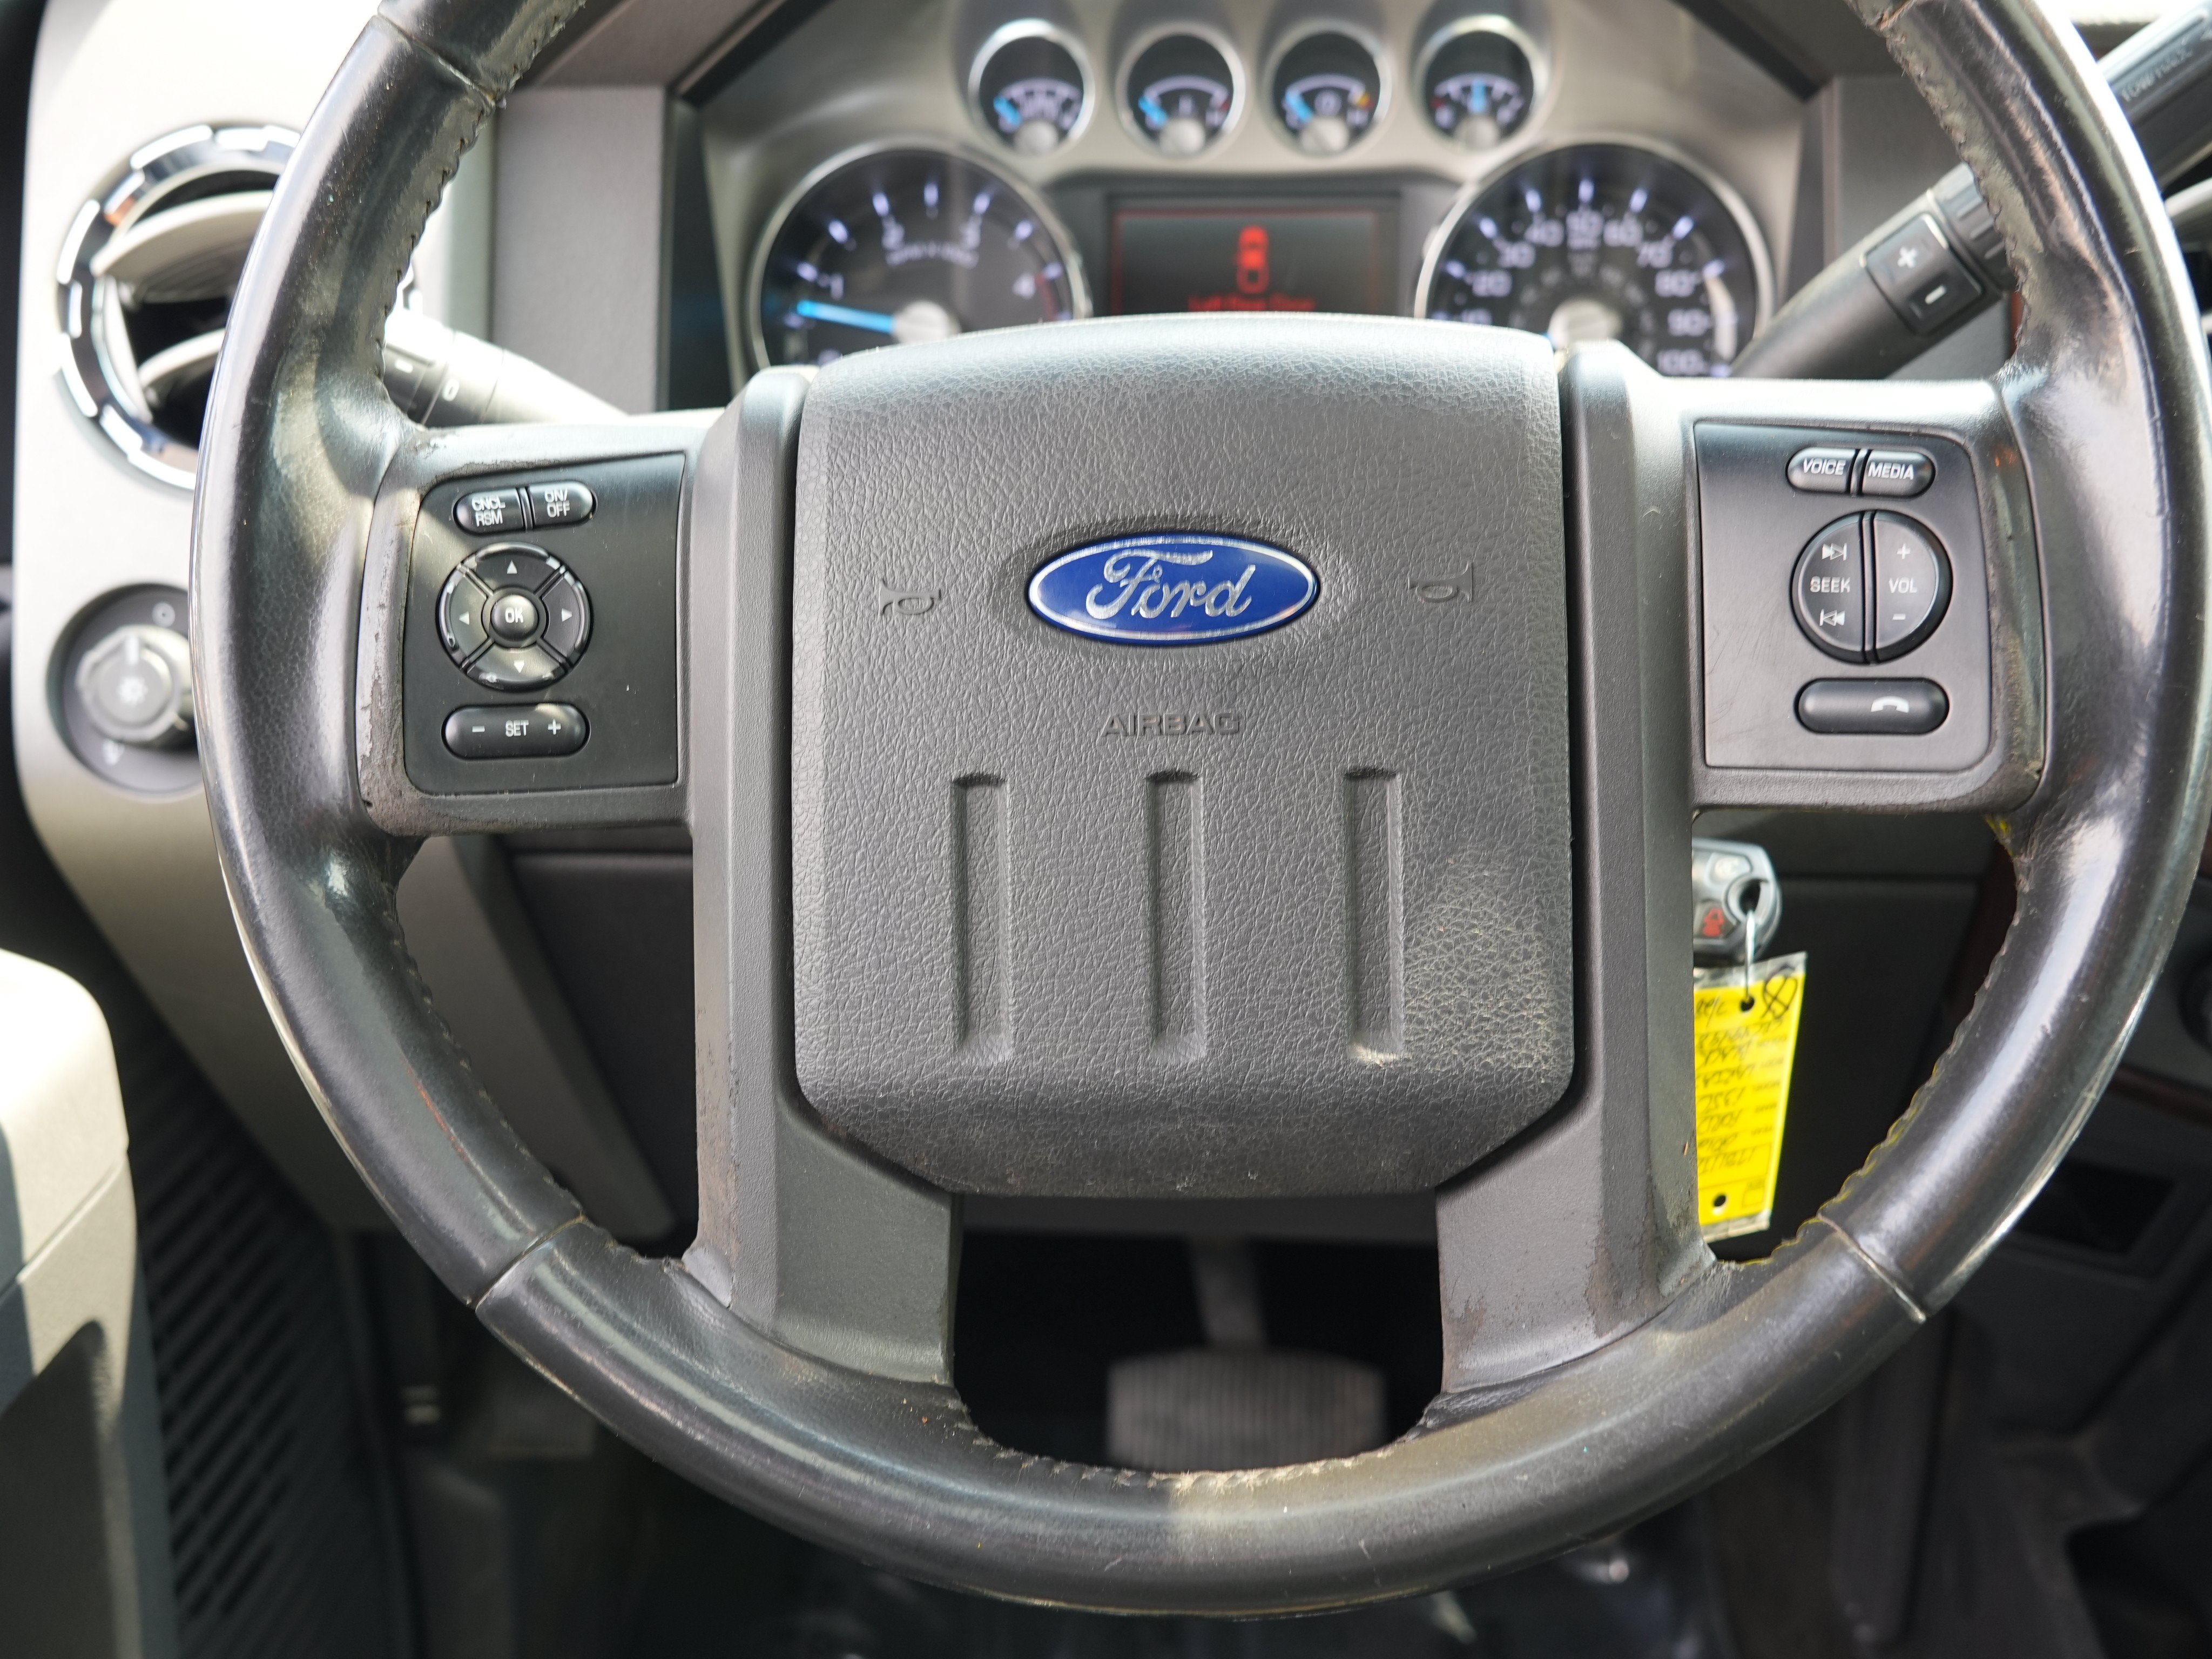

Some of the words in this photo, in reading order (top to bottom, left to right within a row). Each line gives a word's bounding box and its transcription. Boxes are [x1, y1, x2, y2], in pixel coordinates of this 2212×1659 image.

[1802, 458, 1846, 476] VOICE
[1867, 463, 1914, 480] MEDIA
[471, 495, 505, 511] CNCL
[547, 501, 570, 518] OFF
[475, 509, 503, 527] RSM
[1085, 549, 1256, 621] Ford
[1809, 576, 1850, 594] SEEK
[1889, 578, 1918, 594] VOL
[505, 608, 524, 623] OK
[505, 720, 529, 737] SET
[1101, 711, 1241, 737] AIRBAG
